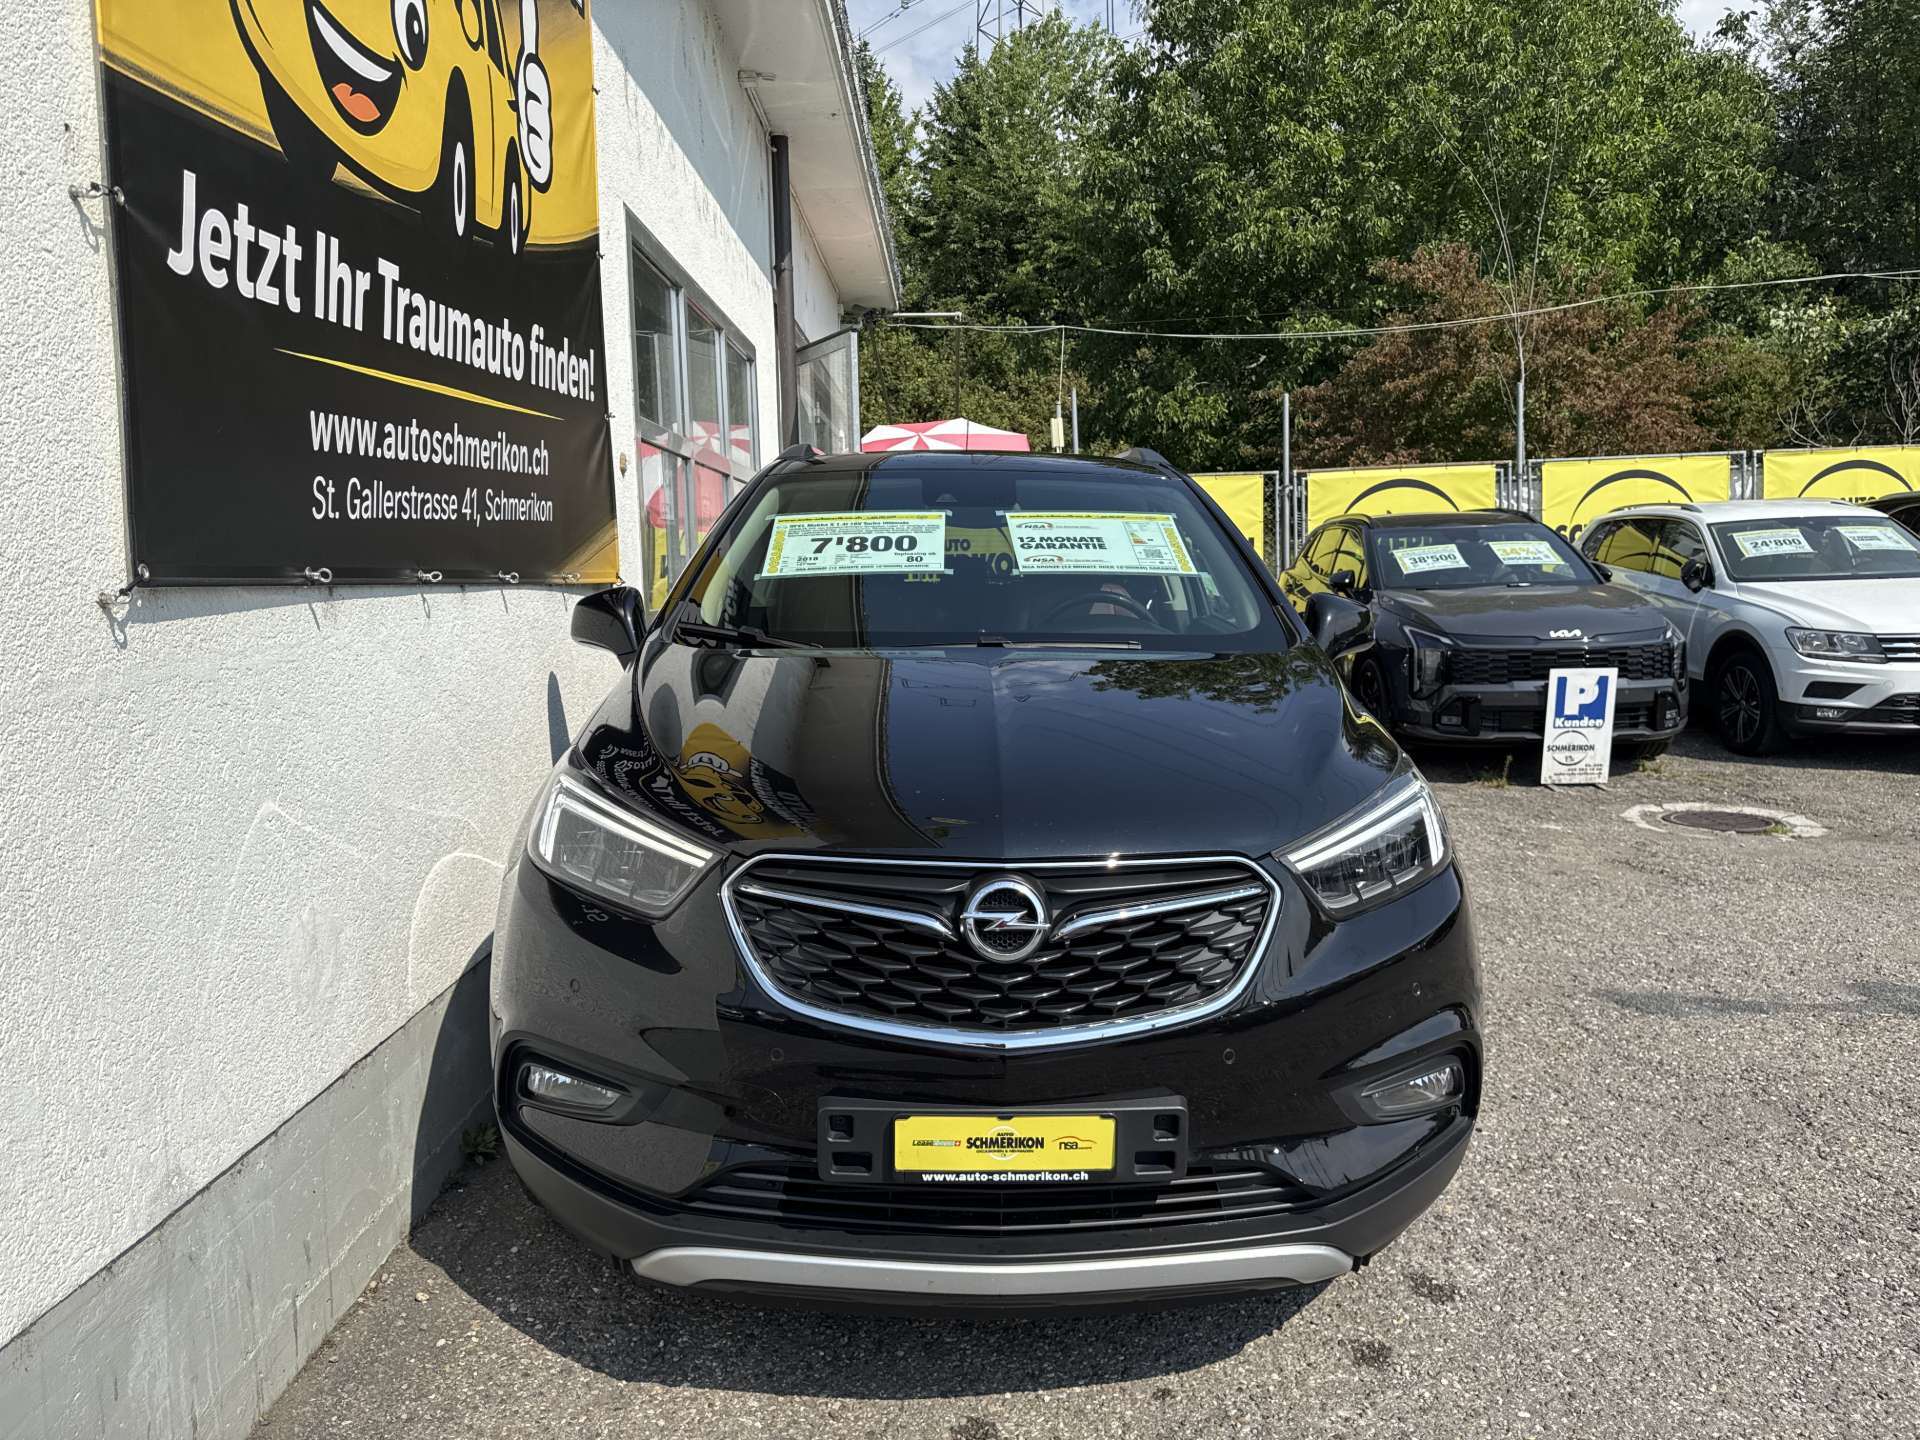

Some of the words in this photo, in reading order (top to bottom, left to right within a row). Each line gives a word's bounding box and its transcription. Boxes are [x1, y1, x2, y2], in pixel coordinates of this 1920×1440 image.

[166, 169, 302, 313] Jetzt
[315, 230, 370, 334] Ihr
[377, 256, 525, 382] Traumauto
[529, 322, 595, 403] finden!
[309, 410, 549, 476] www.autoschmerikon.ch
[311, 475, 341, 521] St.
[346, 476, 458, 522] Gallerstrasse
[460, 486, 481, 528] 41,
[484, 488, 553, 523] Schmerikon
[810, 535, 918, 554] 7'800
[1019, 542, 1108, 550] GARANTIE
[1749, 538, 1802, 550] 24'800
[906, 555, 924, 563] 80
[1408, 553, 1457, 565] 38'500
[1554, 717, 1605, 729] Kunden
[1546, 743, 1595, 753] SCHMERIKON
[966, 1136, 1045, 1150] SCHMERIKON
[1058, 1140, 1079, 1151] nsa
[921, 1172, 1090, 1182] www.auto-schmerikon.ch
